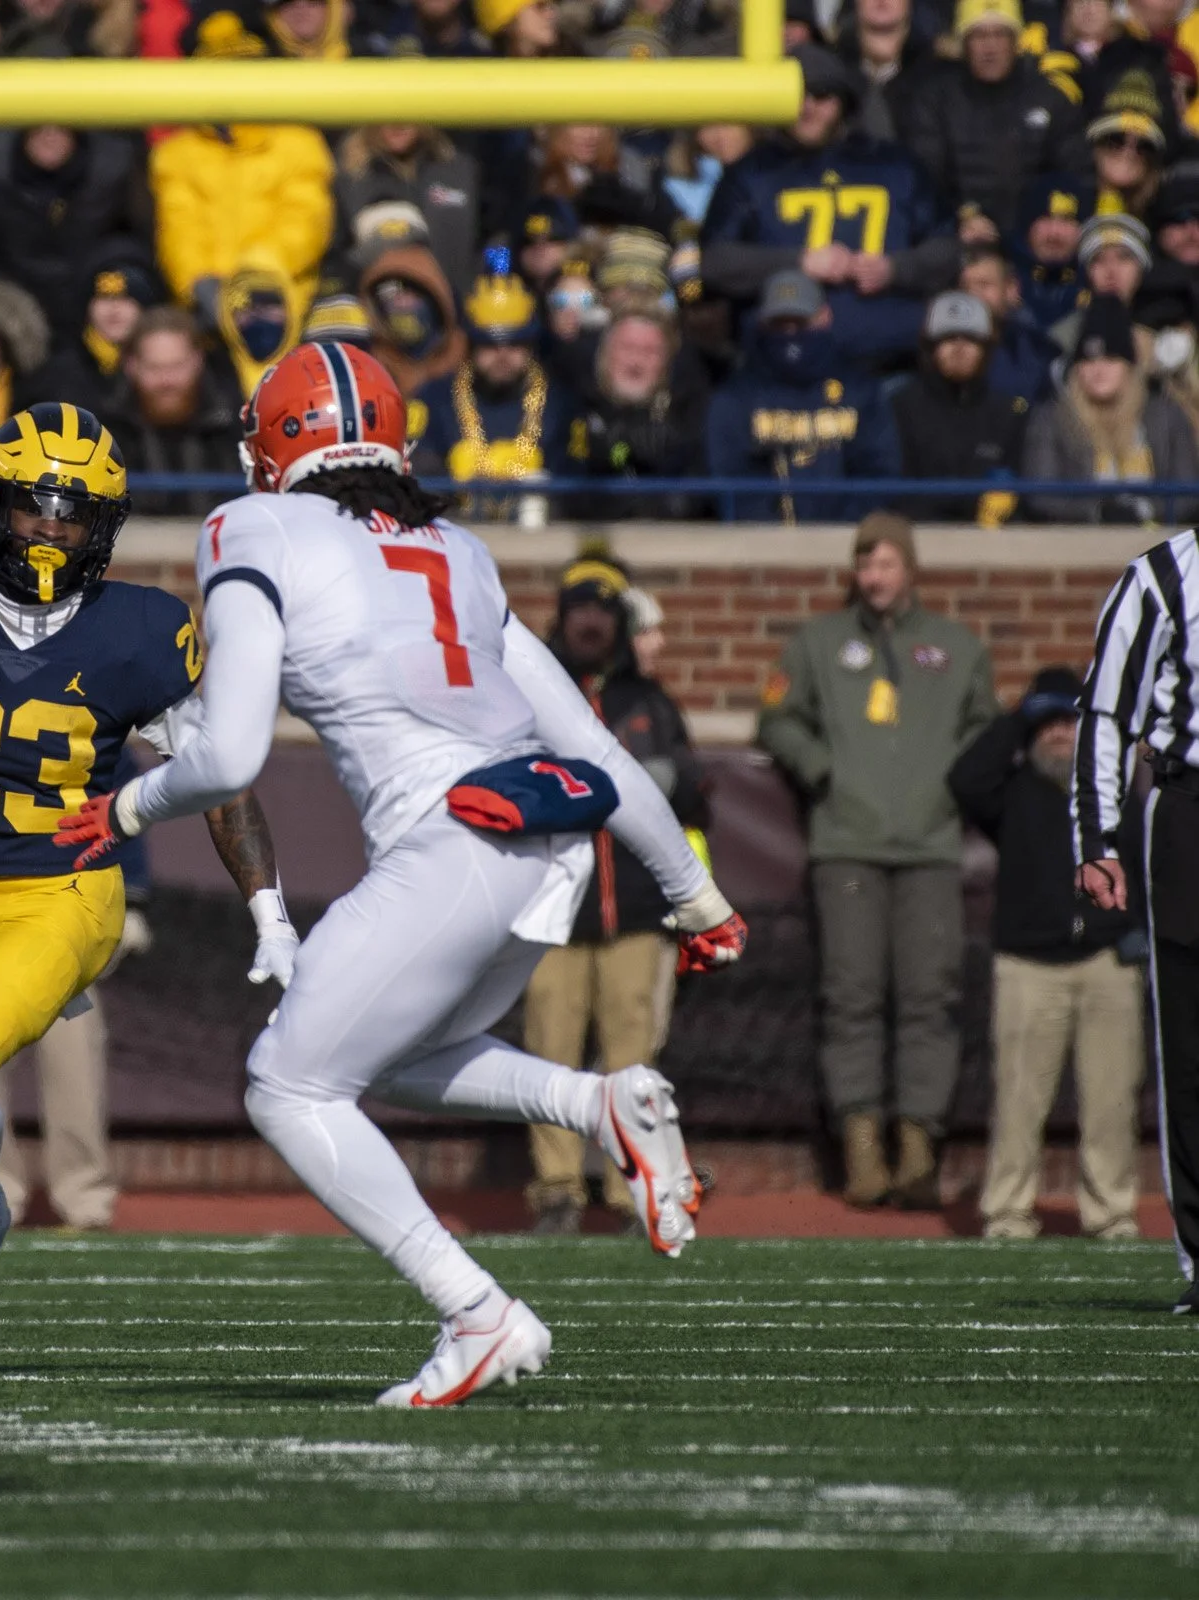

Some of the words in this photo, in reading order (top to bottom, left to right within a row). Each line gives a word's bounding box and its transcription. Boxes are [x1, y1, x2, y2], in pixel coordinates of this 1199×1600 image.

[777, 184, 890, 257] 77
[56, 473, 73, 487] M
[206, 513, 227, 564] 7
[175, 606, 203, 683] 2
[379, 543, 474, 687] 7
